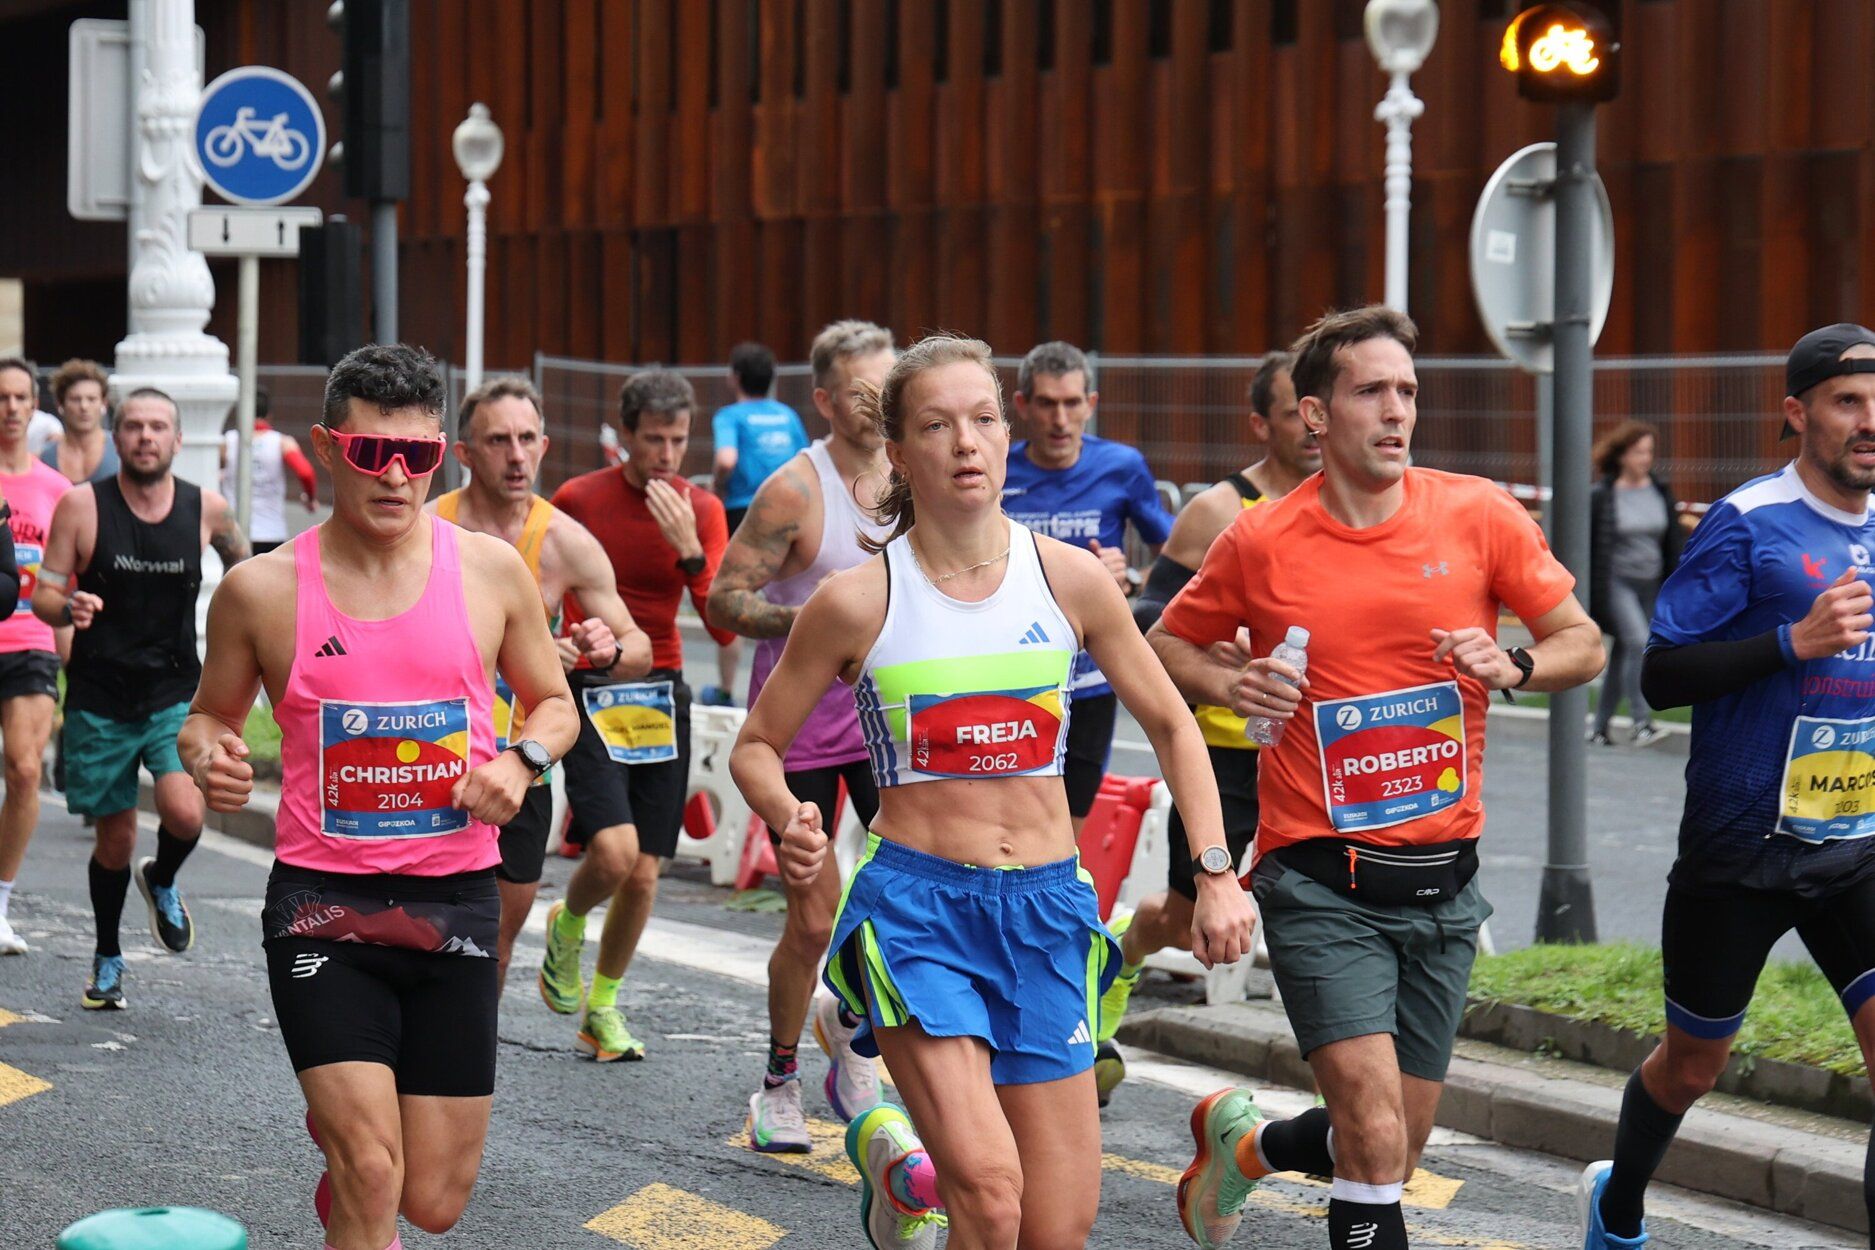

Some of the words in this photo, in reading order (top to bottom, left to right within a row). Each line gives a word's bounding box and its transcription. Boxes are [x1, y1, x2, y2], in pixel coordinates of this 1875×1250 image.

[376, 711, 447, 730] ZURICH
[1370, 697, 1438, 721] ZURICH
[956, 719, 1038, 744] FREJA
[969, 752, 1019, 771] 2062
[1342, 740, 1459, 776] ROBERTO
[340, 759, 462, 784] CHRISTIAN
[1381, 775, 1423, 797] 2323
[377, 792, 423, 809] 2104
